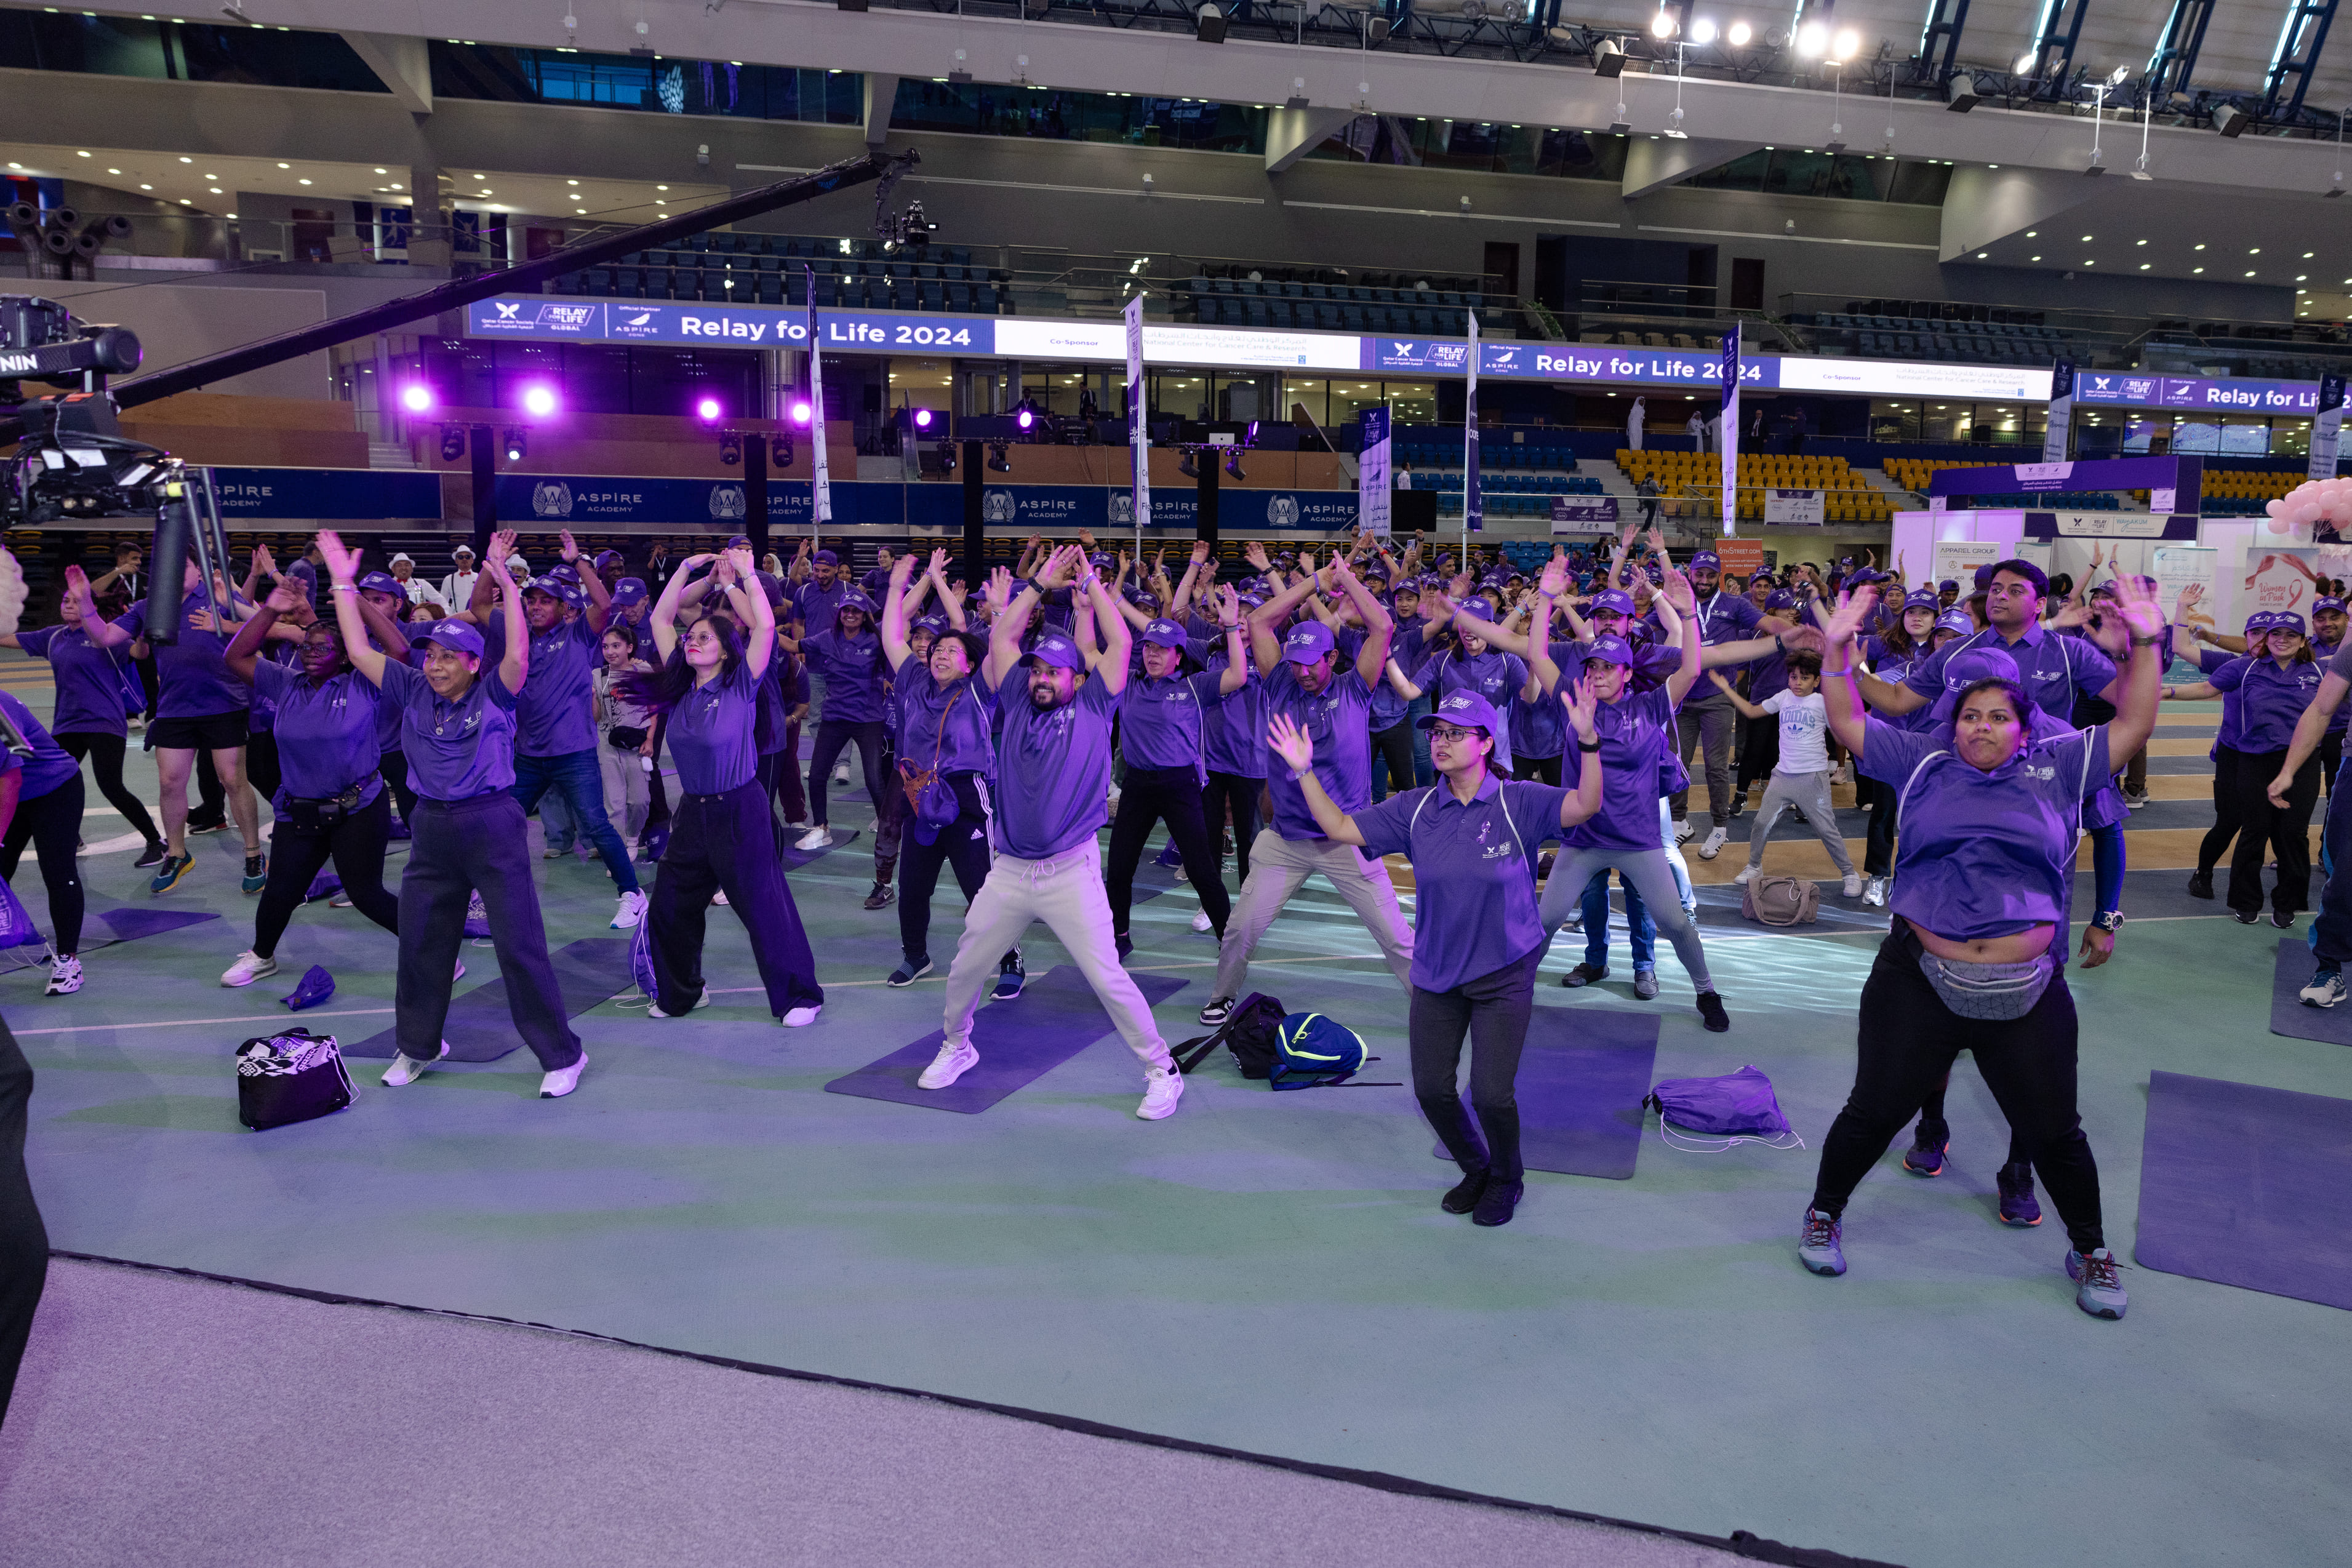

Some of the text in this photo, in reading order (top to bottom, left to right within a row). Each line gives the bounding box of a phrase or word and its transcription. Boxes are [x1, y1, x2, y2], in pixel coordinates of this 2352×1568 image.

[553, 307, 588, 316] RELAY
[561, 315, 583, 324] LIFE
[615, 326, 658, 334] ASPIRE
[681, 316, 971, 346] Relay fo Life 2024
[1050, 338, 1098, 346] Co-Sponsor
[1438, 346, 1466, 355] RELAY
[1537, 354, 1602, 376] Relay
[1610, 358, 1644, 375] for
[1652, 360, 1695, 378] Life
[2129, 380, 2151, 388] RELAY
[2207, 388, 2260, 407] Relay
[2266, 390, 2294, 406] for
[1361, 484, 1387, 492] ASPIRE
[577, 492, 642, 505] ASPIRE
[766, 494, 811, 507] SPIRE
[1020, 499, 1076, 510] ASPIRE
[1303, 504, 1355, 514] ASPIRE
[2258, 582, 2286, 593] Women
[2259, 591, 2284, 601] in Pink
